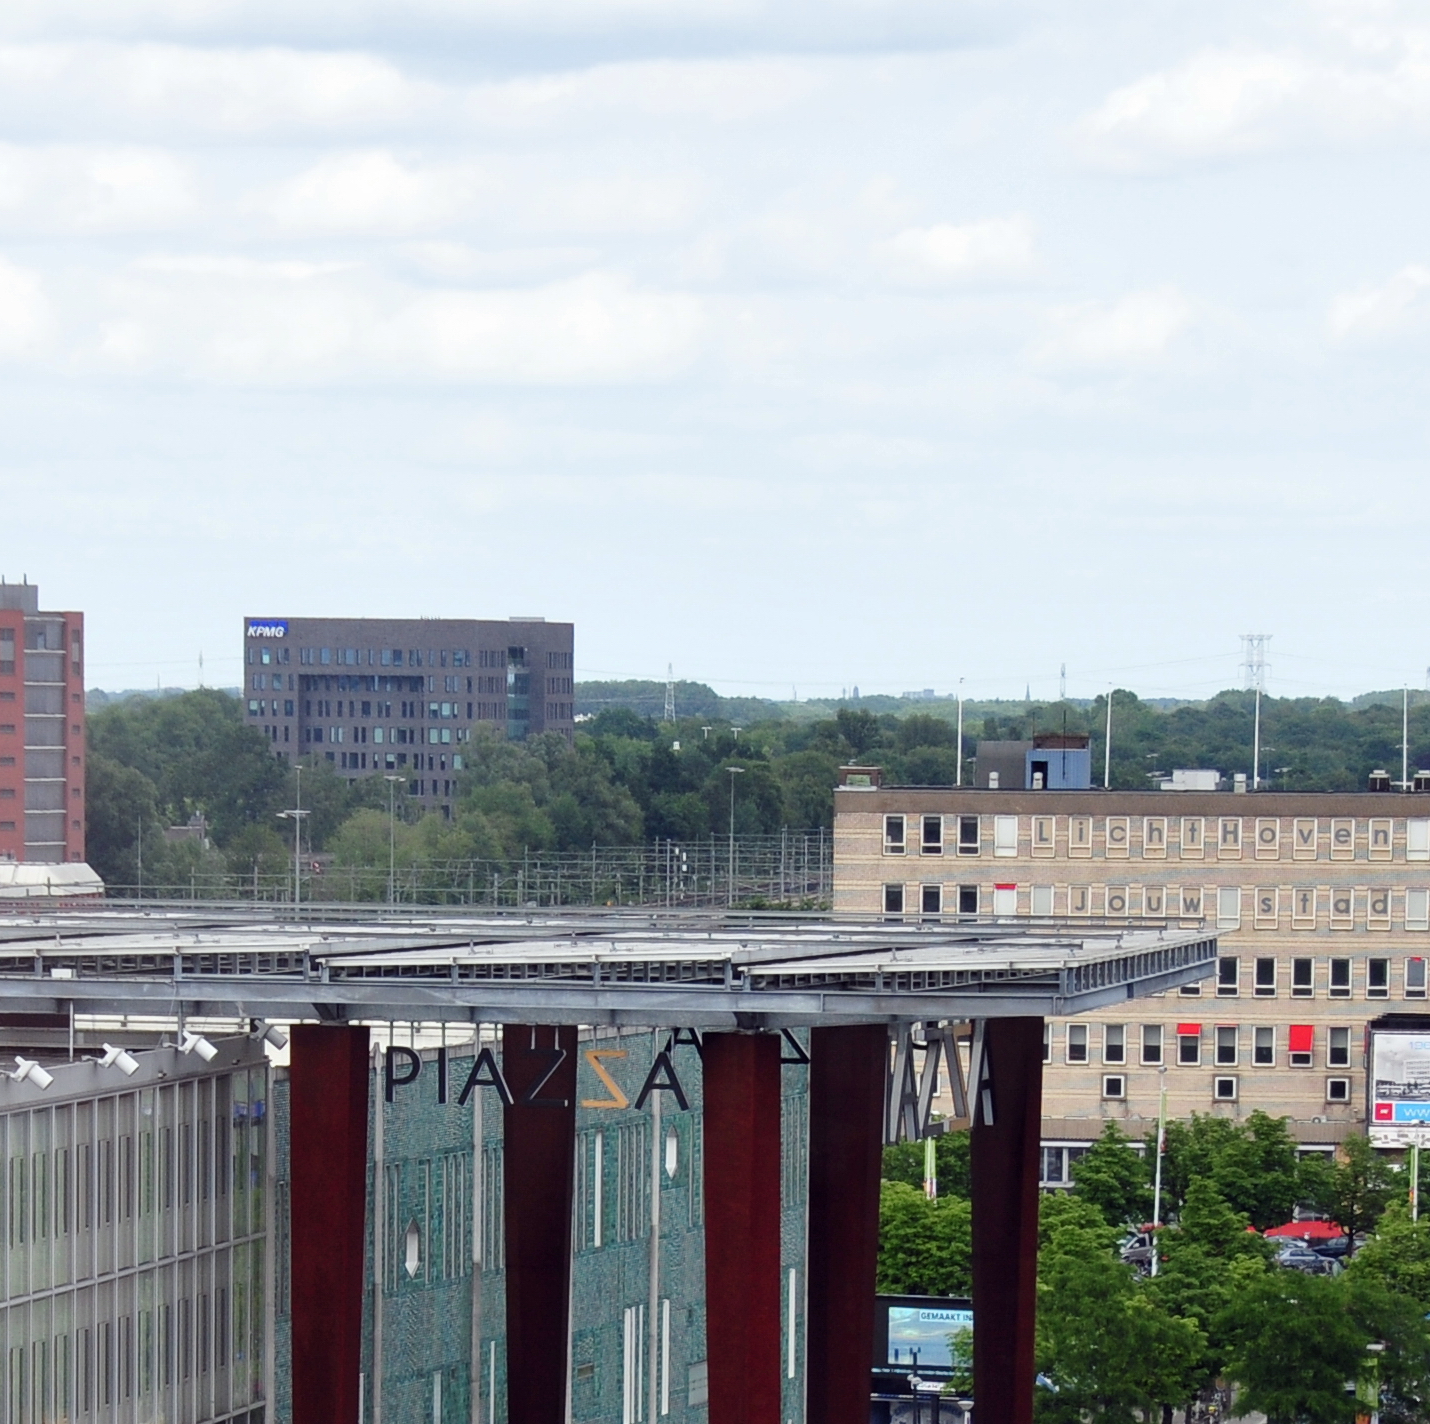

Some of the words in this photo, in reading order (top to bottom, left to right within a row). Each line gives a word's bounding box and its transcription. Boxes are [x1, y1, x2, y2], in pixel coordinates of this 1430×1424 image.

[247, 626, 285, 638] KPMG
[1261, 892, 1389, 915] stad
[921, 1312, 960, 1321] GEMAAKT
